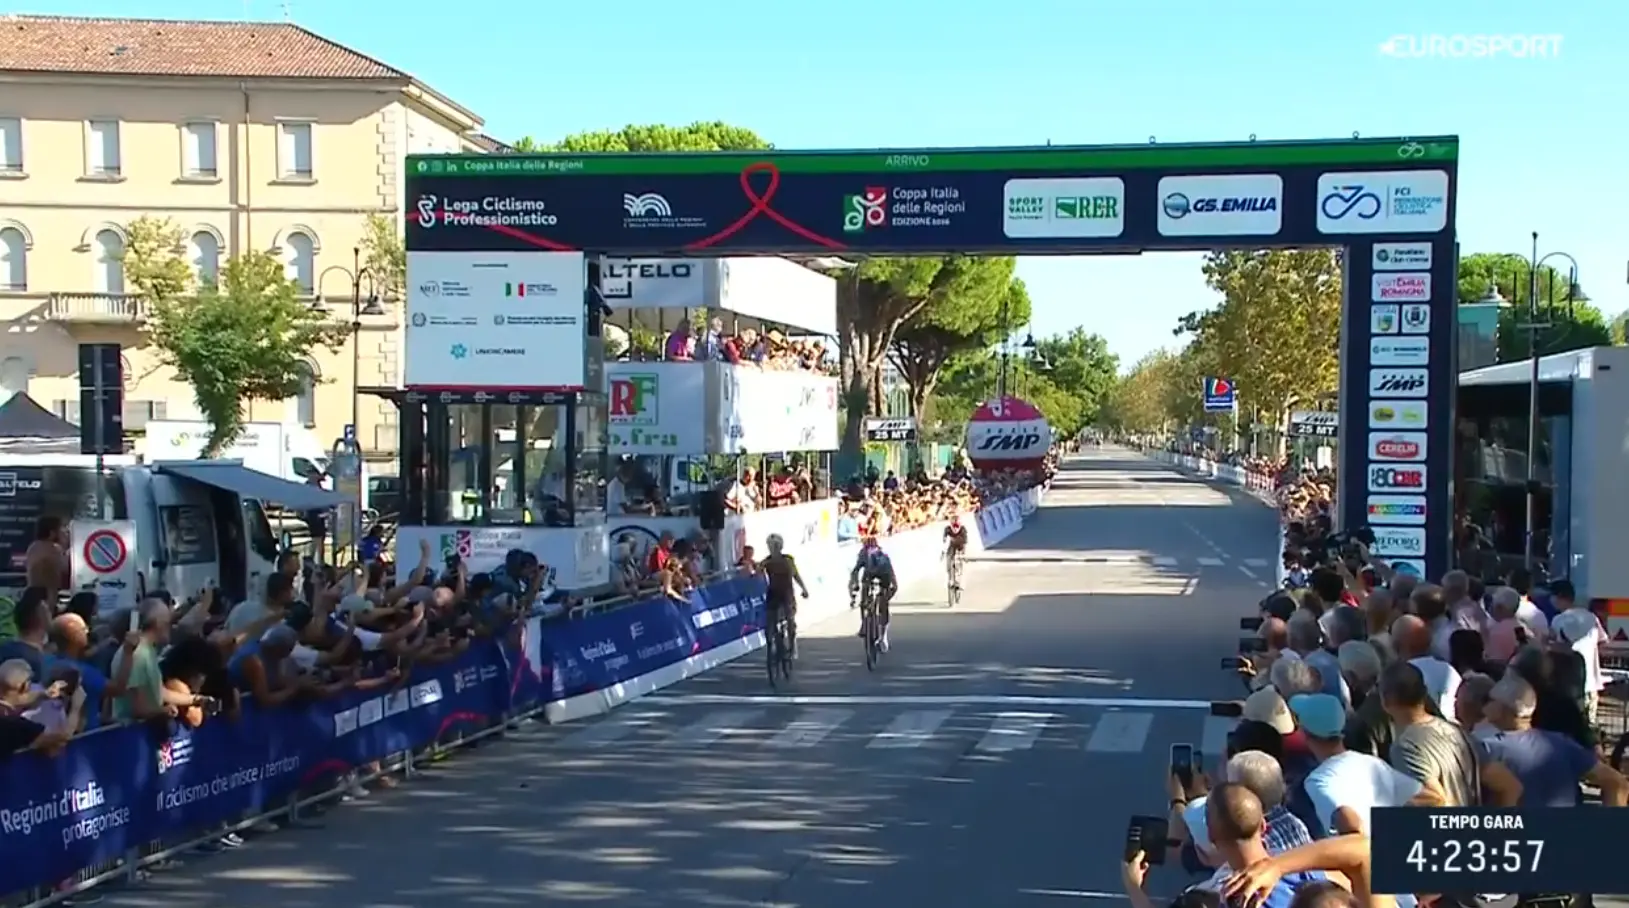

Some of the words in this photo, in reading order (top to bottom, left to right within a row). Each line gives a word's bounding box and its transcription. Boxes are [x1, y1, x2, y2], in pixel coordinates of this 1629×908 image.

[464, 160, 494, 172] Coppa
[496, 160, 521, 171] Italia
[523, 160, 546, 171] delle
[548, 160, 584, 172] Regioni
[885, 154, 930, 167] ARRIVO
[892, 187, 927, 201] Coppa
[931, 186, 959, 198] Italia
[1394, 187, 1411, 196] FCI
[443, 198, 479, 213] Lega
[482, 197, 545, 211] Ciclismo
[1008, 197, 1043, 205] SPORT
[1079, 196, 1119, 219] RER
[1193, 197, 1276, 213] GS.EMILIA
[892, 201, 920, 214] delle
[924, 201, 965, 216] Regioni
[443, 212, 558, 226] Professionistico
[892, 217, 931, 226] EDIZIONE
[603, 264, 691, 278] LTELO
[891, 430, 908, 440] MT
[1298, 424, 1313, 435] 25
[1315, 426, 1335, 436] MT
[977, 434, 1041, 451] SMP
[165, 783, 209, 809] ciclismo
[211, 774, 229, 796] che
[230, 767, 259, 790] unisce
[0, 794, 58, 835] Regioni
[60, 781, 105, 816] d'Italia
[62, 806, 130, 850] protagoniste
